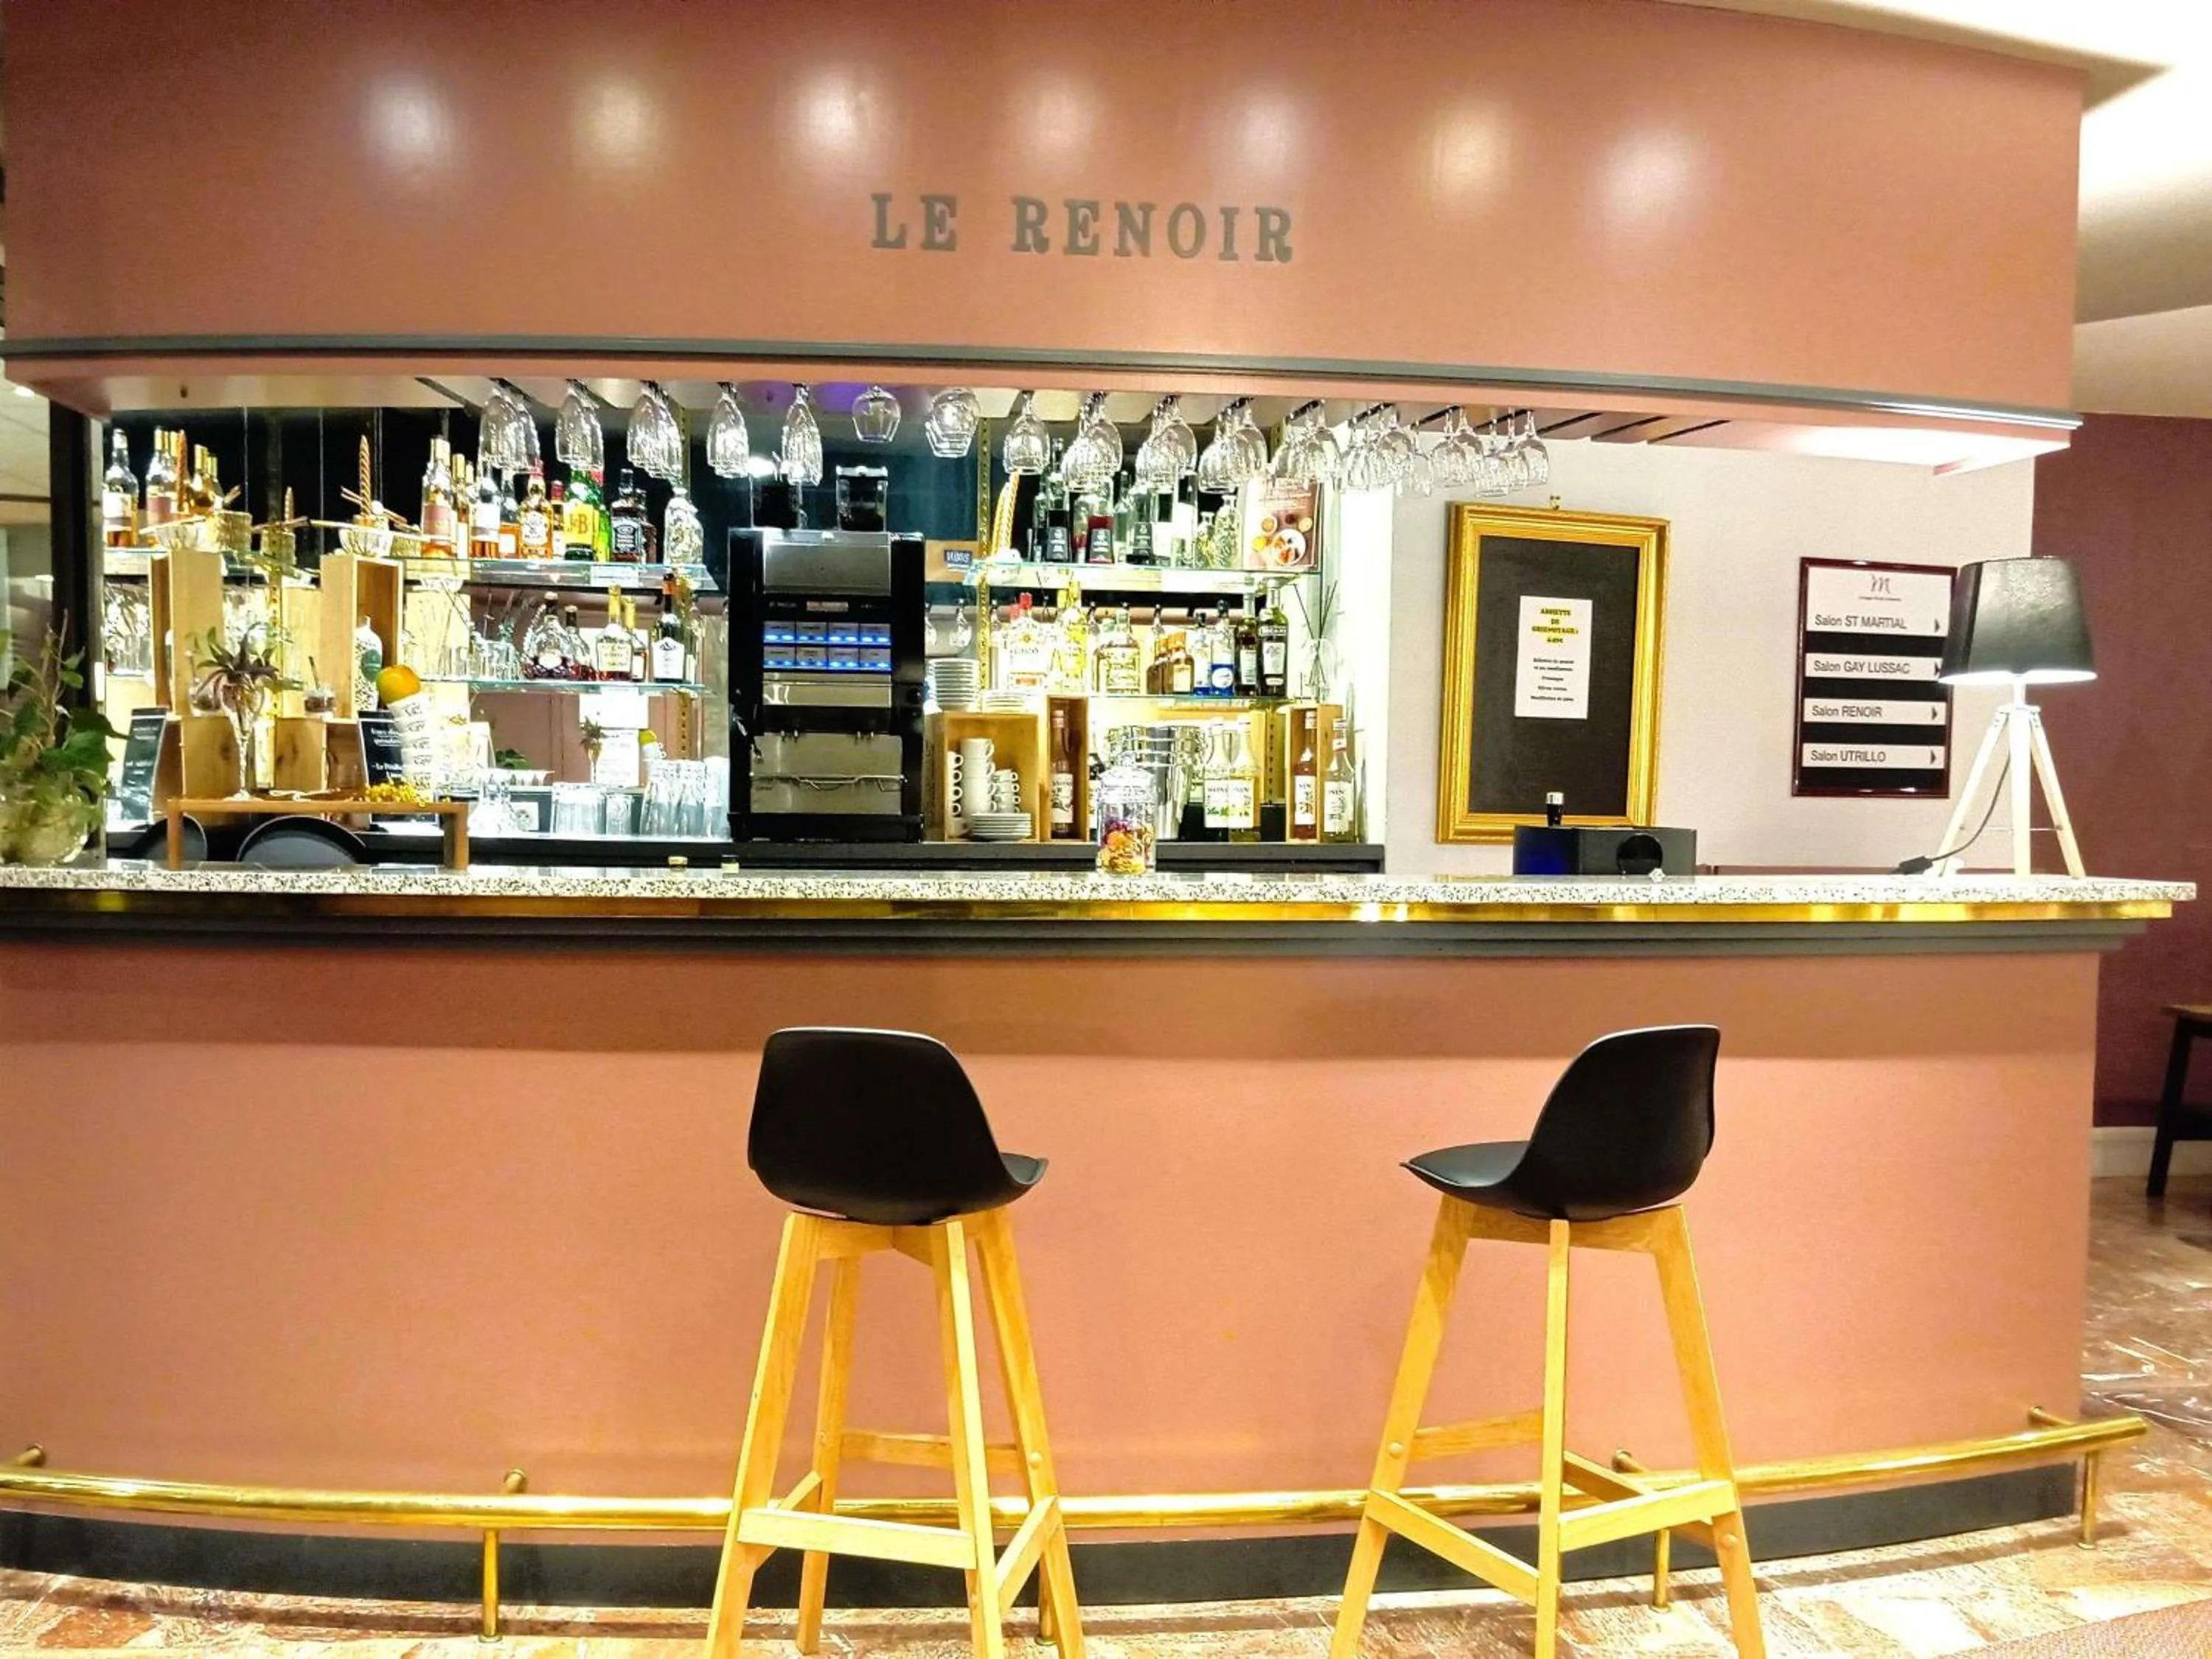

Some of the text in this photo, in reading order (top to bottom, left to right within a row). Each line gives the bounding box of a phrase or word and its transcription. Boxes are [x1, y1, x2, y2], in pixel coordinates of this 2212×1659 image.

[871, 192, 1293, 264] LE RENOIR
[1815, 614, 1907, 630] Salon ST MARTIAL
[1813, 661, 1910, 675] Salon GAY LUSSAC
[1812, 706, 1883, 717] Salon RENOIR
[1810, 750, 1887, 763] Salon UTRILLO
